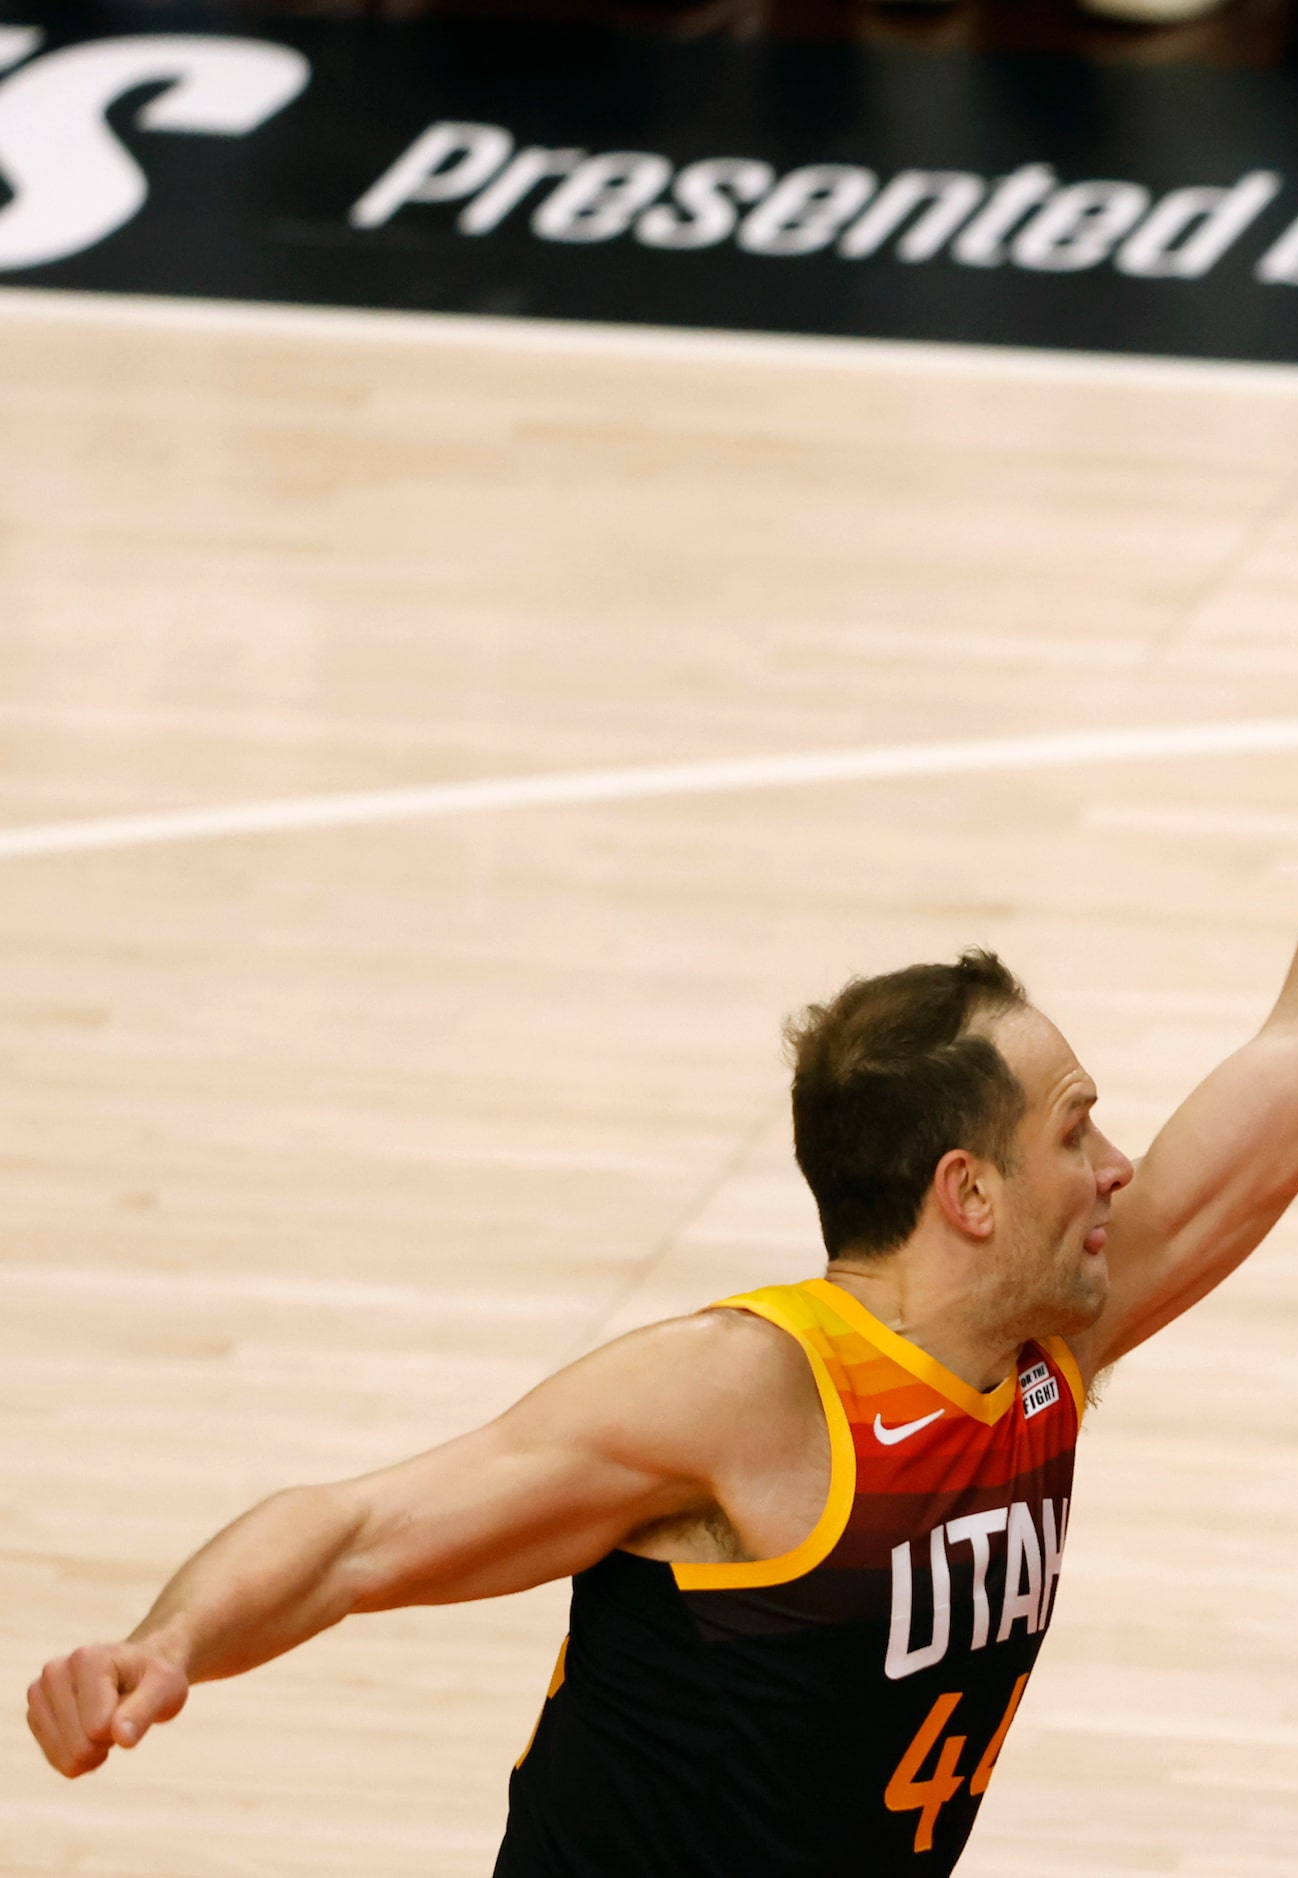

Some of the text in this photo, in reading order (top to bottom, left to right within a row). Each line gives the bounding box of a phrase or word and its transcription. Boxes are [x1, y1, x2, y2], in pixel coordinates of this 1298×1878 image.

[349, 119, 1283, 281] Presented
[1022, 1380, 1056, 1415] FIGHT
[1032, 1364, 1046, 1380] THE
[884, 1498, 1068, 1681] UTAH
